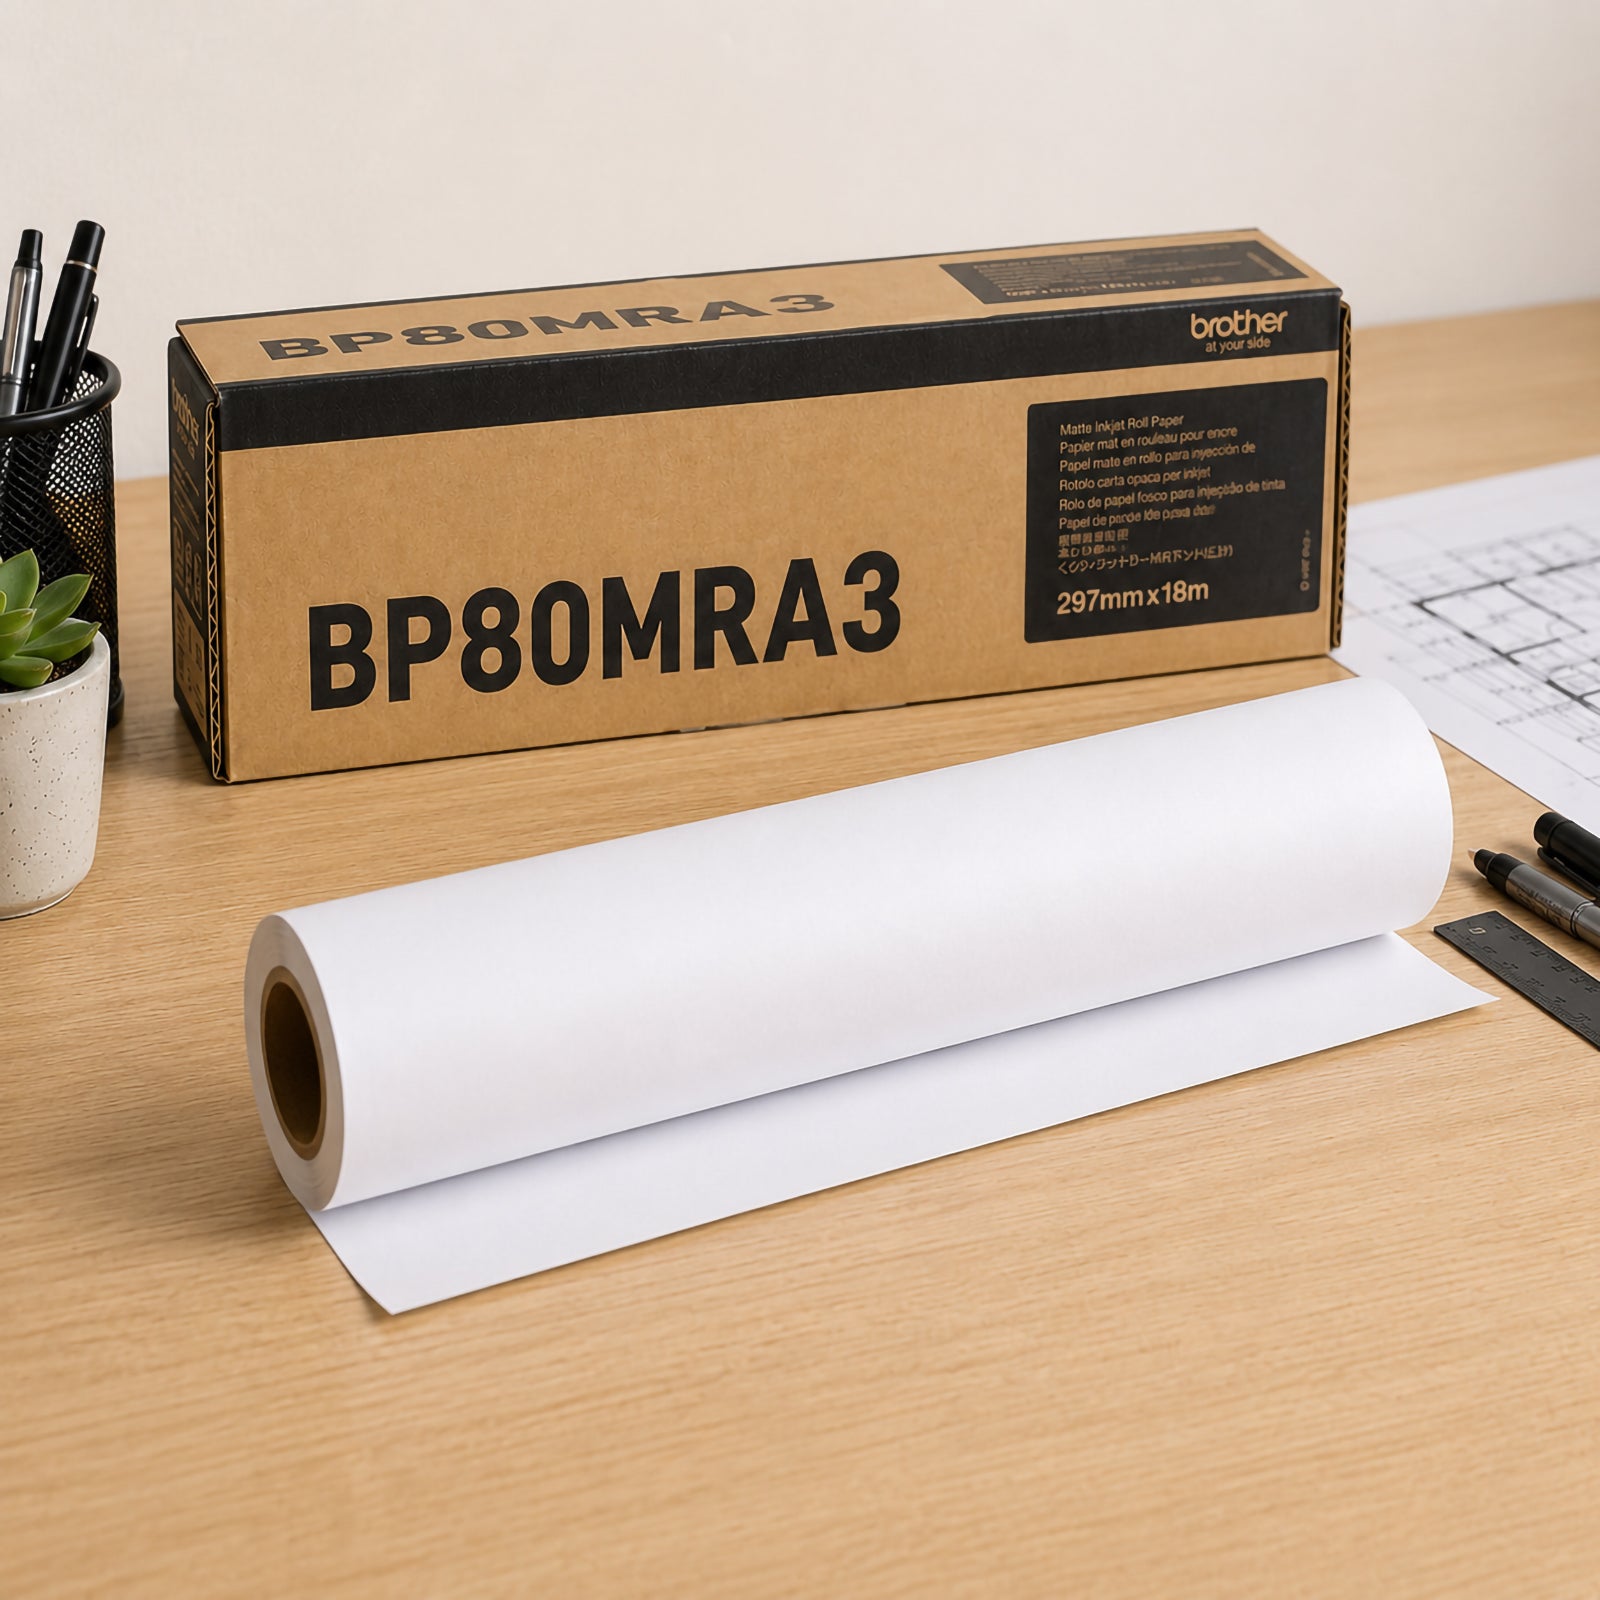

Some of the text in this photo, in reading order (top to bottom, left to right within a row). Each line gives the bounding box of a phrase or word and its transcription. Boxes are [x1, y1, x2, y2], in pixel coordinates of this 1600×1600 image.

[259, 294, 835, 361] BP80MRA3
[1190, 309, 1288, 340] brother
[1205, 336, 1272, 354] at your side
[1060, 415, 1184, 436] Matte Inkjet Roll Paper
[1060, 441, 1095, 456] Papier
[1120, 438, 1135, 448] en
[1180, 430, 1205, 444] pour
[1207, 426, 1238, 439] encre
[1060, 457, 1091, 474] Papel
[1122, 455, 1137, 466] en
[1241, 441, 1256, 453] de
[1162, 470, 1181, 484] per
[1104, 492, 1135, 510] papel
[1059, 516, 1091, 531] Papel
[1057, 588, 1143, 614] 297mm
[1161, 580, 1209, 604] 18m
[308, 550, 901, 711] BP80MRA3
